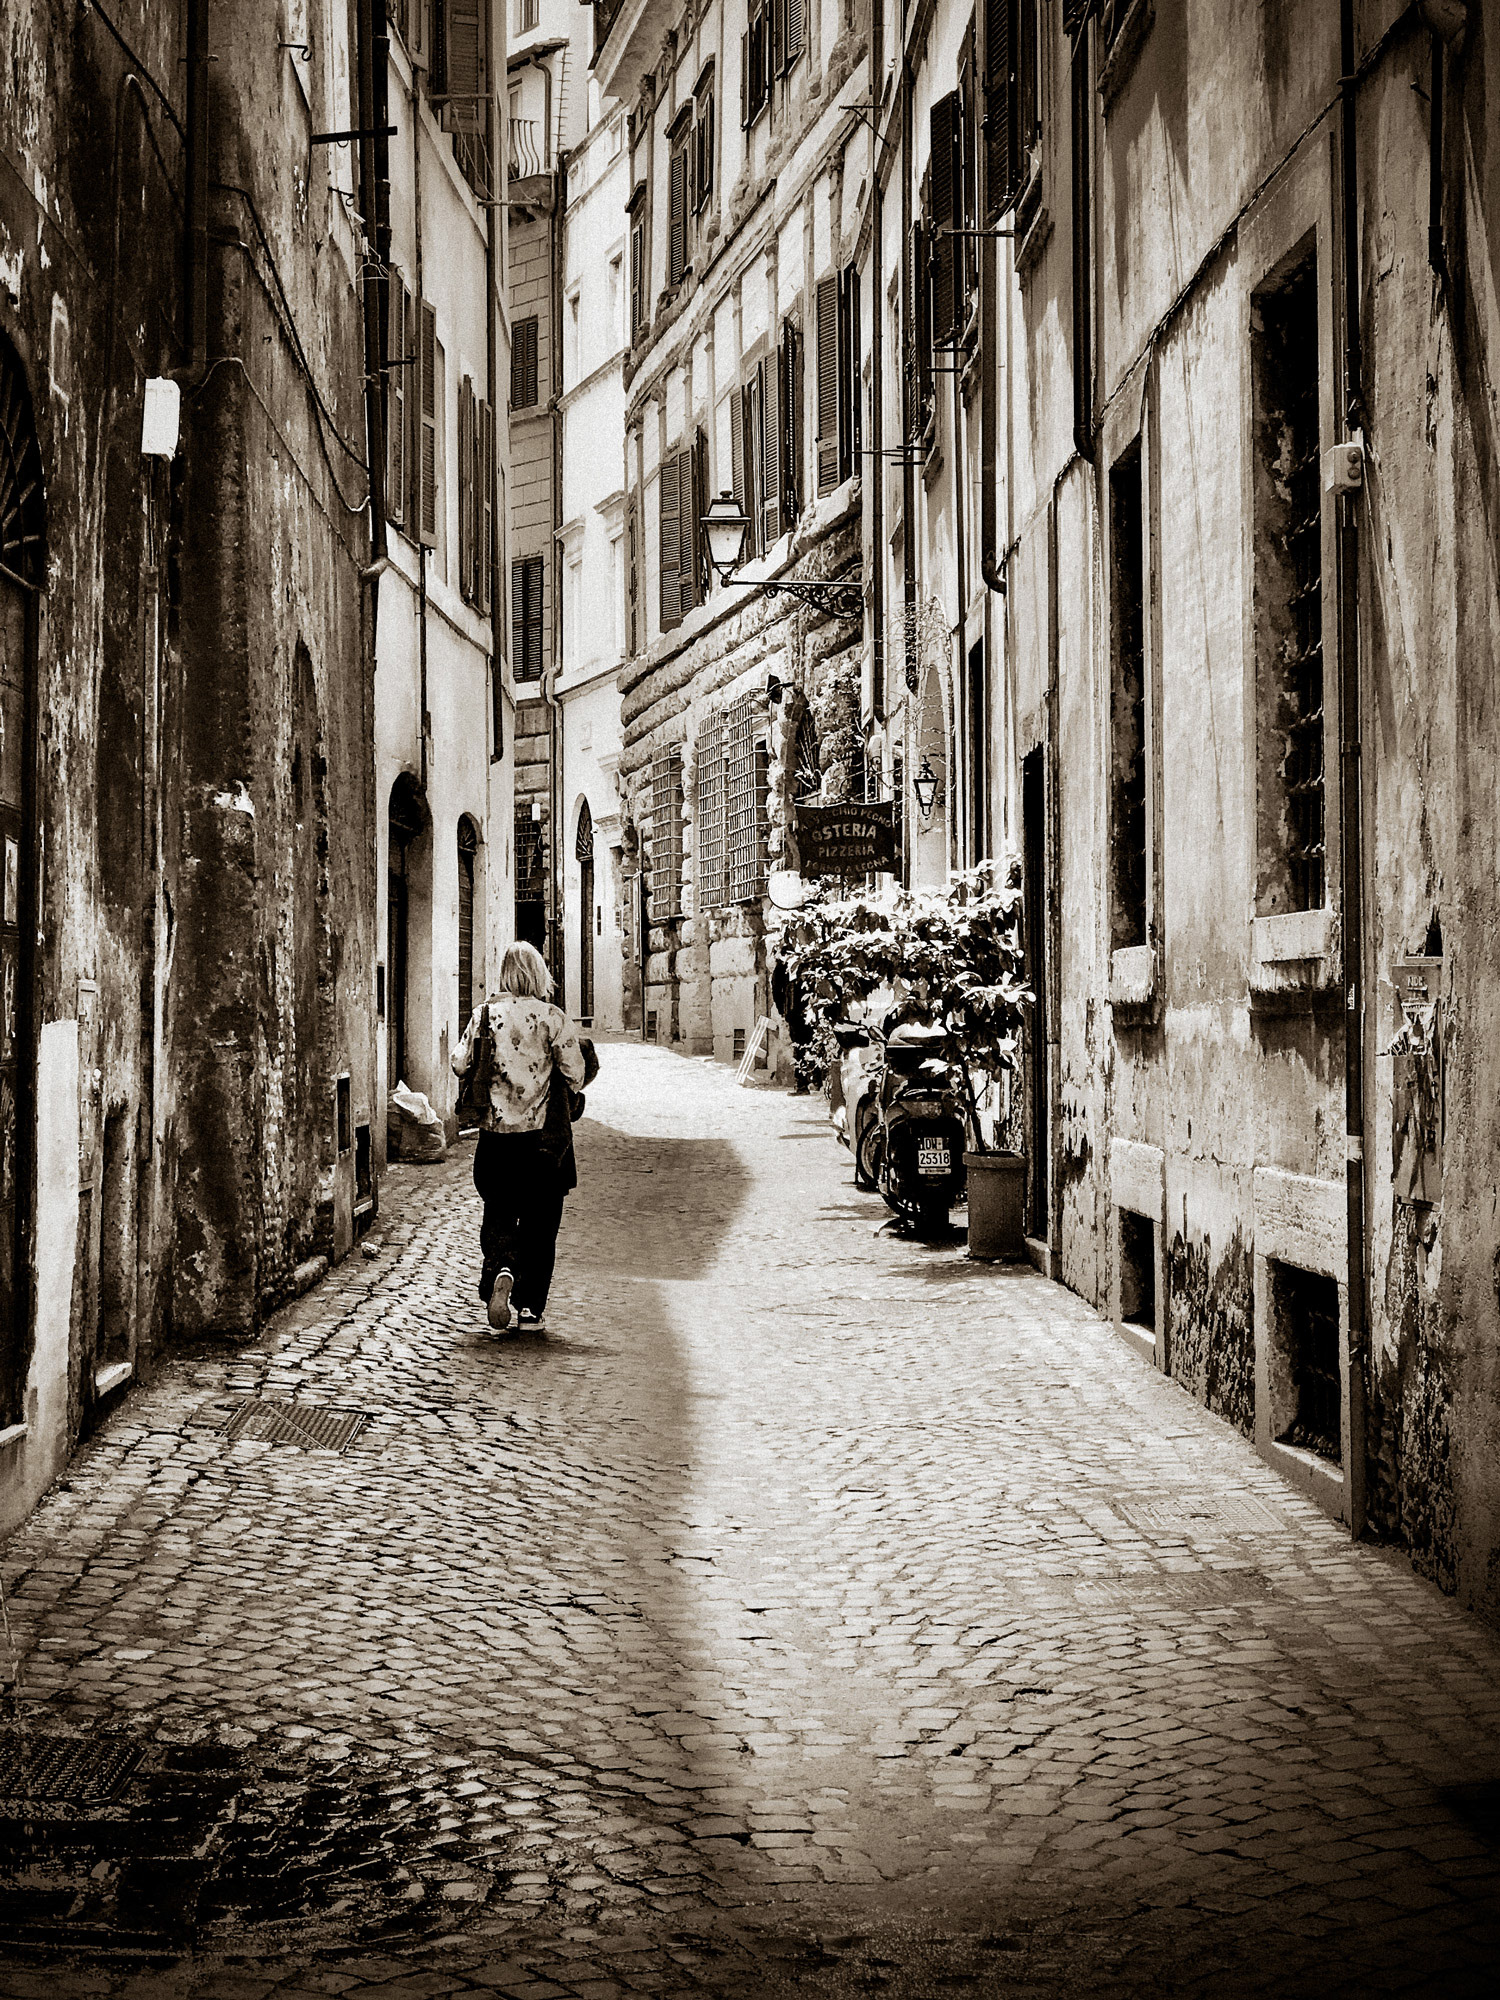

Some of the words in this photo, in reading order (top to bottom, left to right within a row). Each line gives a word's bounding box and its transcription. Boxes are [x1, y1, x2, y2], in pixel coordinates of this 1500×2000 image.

[811, 822, 877, 842] OSTERIA
[818, 844, 875, 857] PIZZERIA
[919, 1152, 951, 1165] 25318
